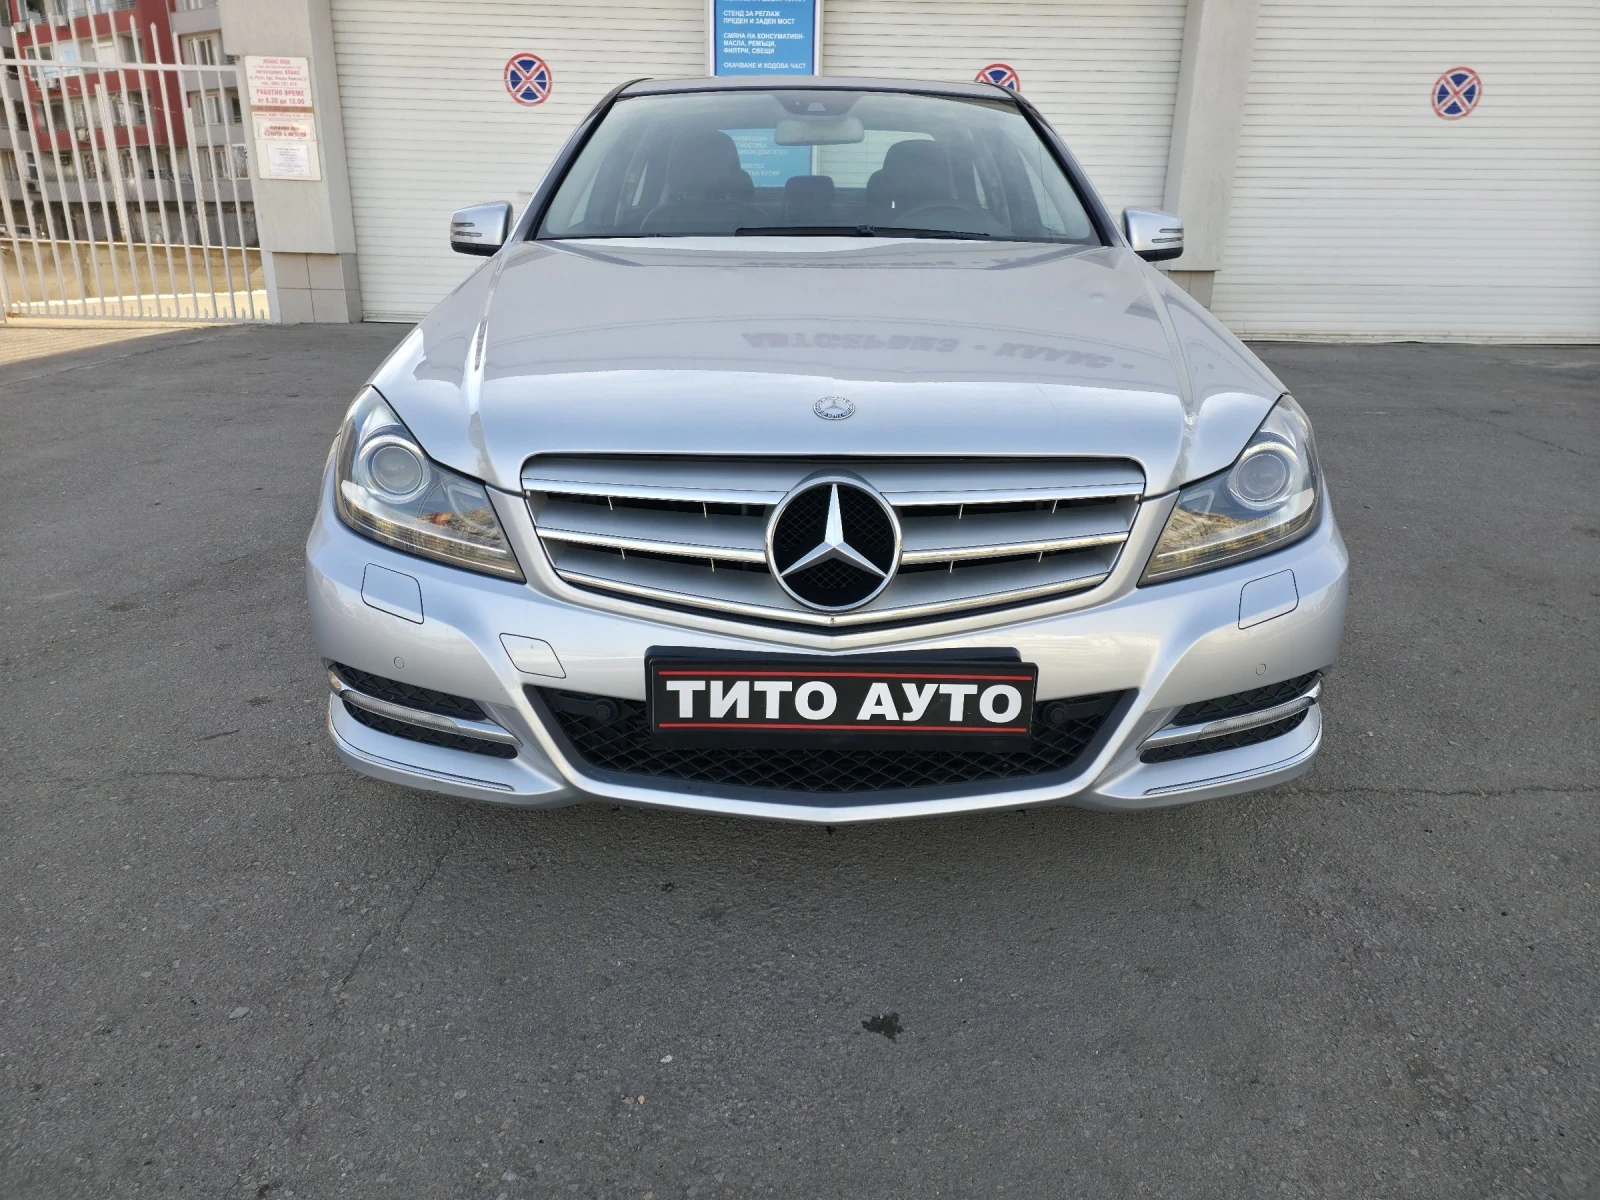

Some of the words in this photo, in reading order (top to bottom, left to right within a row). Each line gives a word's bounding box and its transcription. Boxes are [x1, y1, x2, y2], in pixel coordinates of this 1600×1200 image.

[763, 62, 789, 70] ХОДОВА
[666, 680, 838, 721] ТИТО
[856, 682, 1022, 724] АУТО
